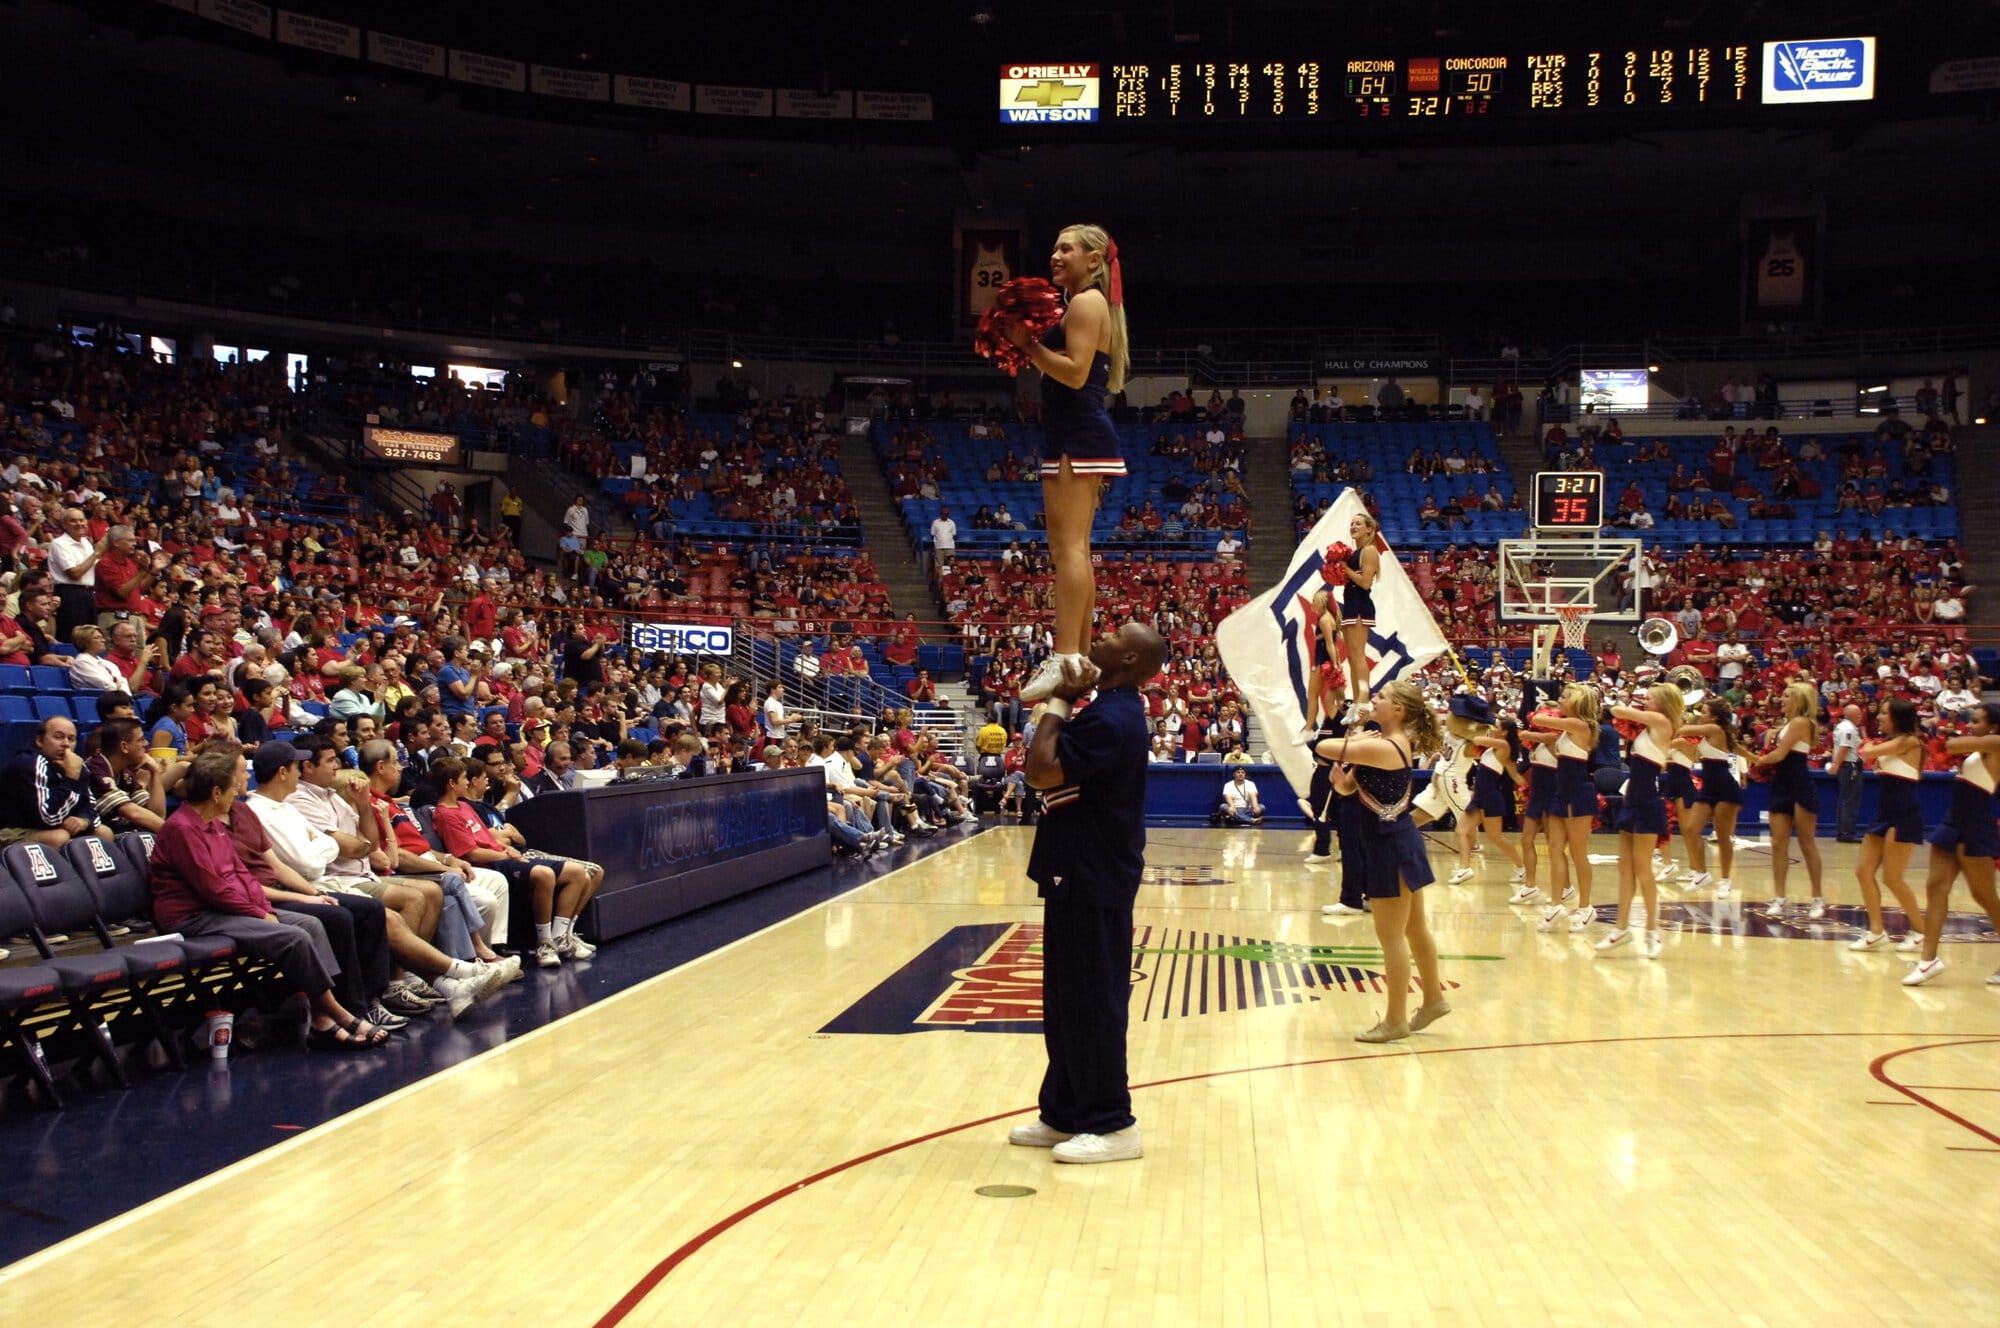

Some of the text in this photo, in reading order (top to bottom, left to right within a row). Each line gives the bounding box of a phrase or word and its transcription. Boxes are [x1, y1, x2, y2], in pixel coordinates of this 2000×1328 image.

[1527, 47, 1748, 68] PLYR 7 9 10 12 15
[1795, 47, 1846, 60] Tucson
[1113, 63, 1319, 78] PLYR 5 13 34 42 43
[1347, 60, 1395, 73] ARIZONA
[1446, 56, 1508, 70] CONCORDIA
[1800, 58, 1856, 71] Electric
[1008, 65, 1092, 79] O'RIELLY
[1534, 68, 1561, 81] PTS
[1688, 61, 1710, 75] 13
[1804, 71, 1856, 83] Power
[1119, 78, 1144, 91] PTS
[1162, 78, 1181, 90] 13
[1230, 76, 1250, 89] 14
[1299, 76, 1319, 88] 12
[1361, 76, 1385, 95] 64
[1467, 74, 1491, 92] 50
[1531, 81, 1563, 94] RBS
[1588, 79, 1599, 92] 0
[1699, 75, 1710, 88] 7
[1116, 91, 1147, 104] RBS
[1239, 89, 1250, 102] 3
[1273, 89, 1284, 102] 3
[1308, 89, 1318, 101] 4
[1531, 94, 1563, 108] FLS
[1587, 93, 1599, 106] 3
[1624, 91, 1636, 104] 0
[1116, 104, 1147, 117] FLS
[1204, 103, 1215, 116] 0
[1273, 102, 1284, 115] 0
[1307, 102, 1319, 115] 3
[1408, 97, 1451, 115] 3:21
[1008, 109, 1092, 122] WATSON
[1767, 258, 1795, 277] 25
[977, 270, 1003, 287] 32
[1324, 360, 1430, 369] HALL OF CHAMPIONS
[384, 448, 442, 461] 327-7463
[1555, 478, 1596, 493] 3:21
[1552, 499, 1588, 522] 35
[1091, 554, 1102, 562] 20
[1418, 555, 1428, 563] 21
[1778, 553, 1790, 563] 22
[634, 628, 730, 651] GEICO
